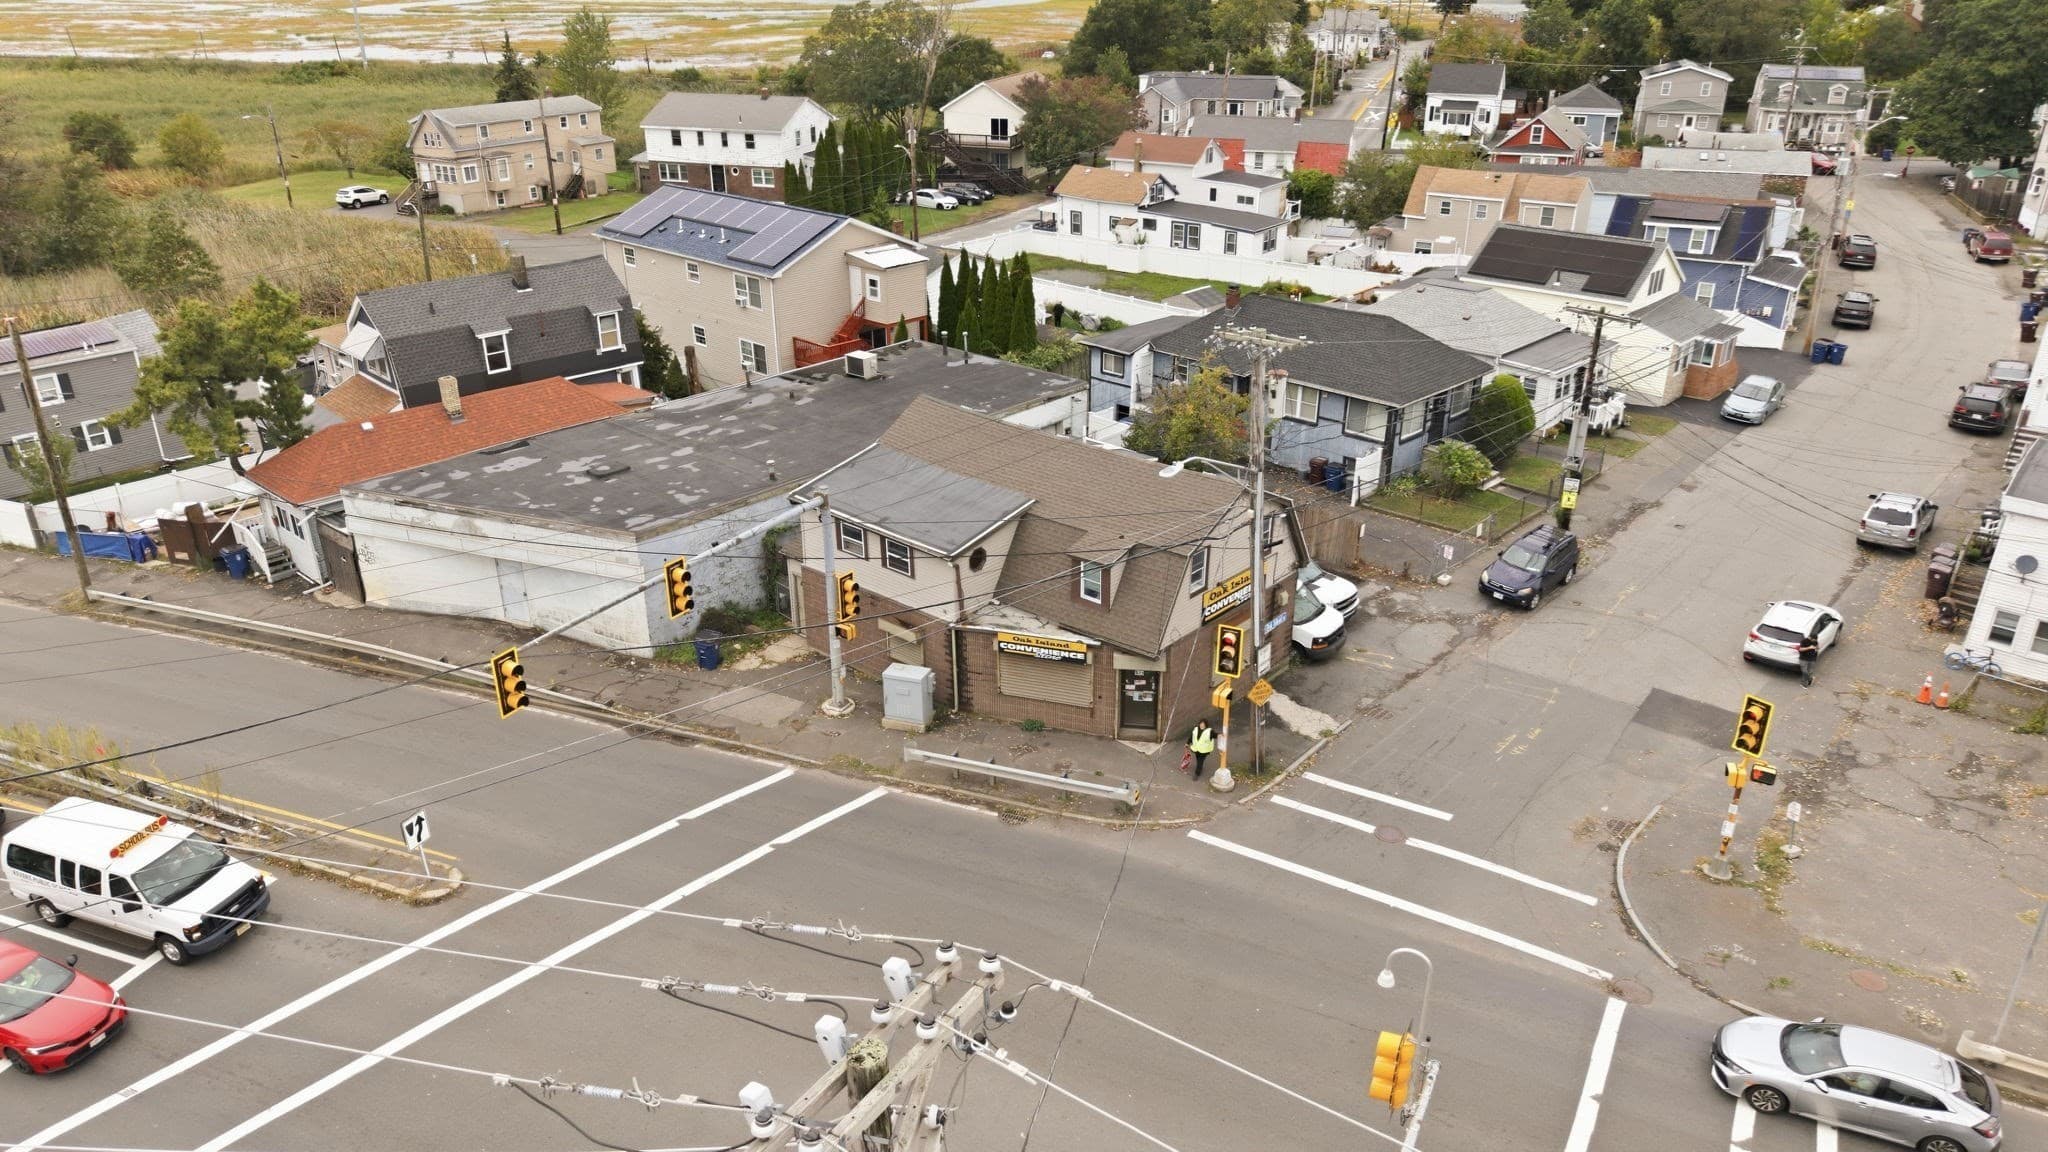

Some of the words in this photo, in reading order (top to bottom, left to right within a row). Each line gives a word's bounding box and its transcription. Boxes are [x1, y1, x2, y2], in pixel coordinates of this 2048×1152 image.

[1209, 585, 1229, 601] Oak
[999, 642, 1085, 660] CONVENIENCE
[1035, 639, 1070, 649] Island
[119, 832, 146, 853] SCHOOL
